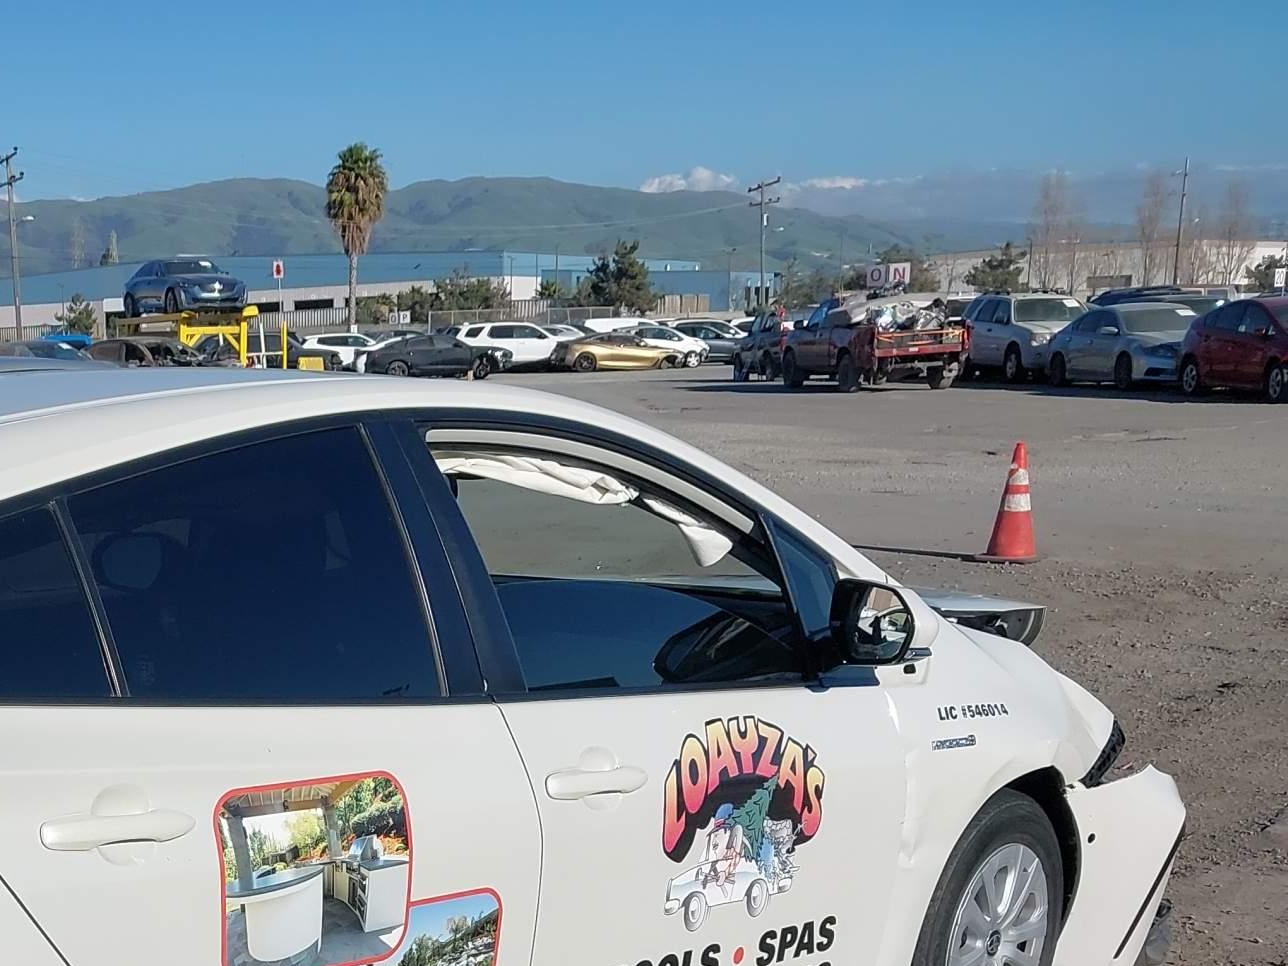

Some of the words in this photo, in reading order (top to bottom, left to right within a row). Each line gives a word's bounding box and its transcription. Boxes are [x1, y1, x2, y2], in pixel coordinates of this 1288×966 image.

[937, 705, 958, 721] LIC
[961, 703, 1009, 719] #546014
[662, 715, 825, 860] LOAYZA'S
